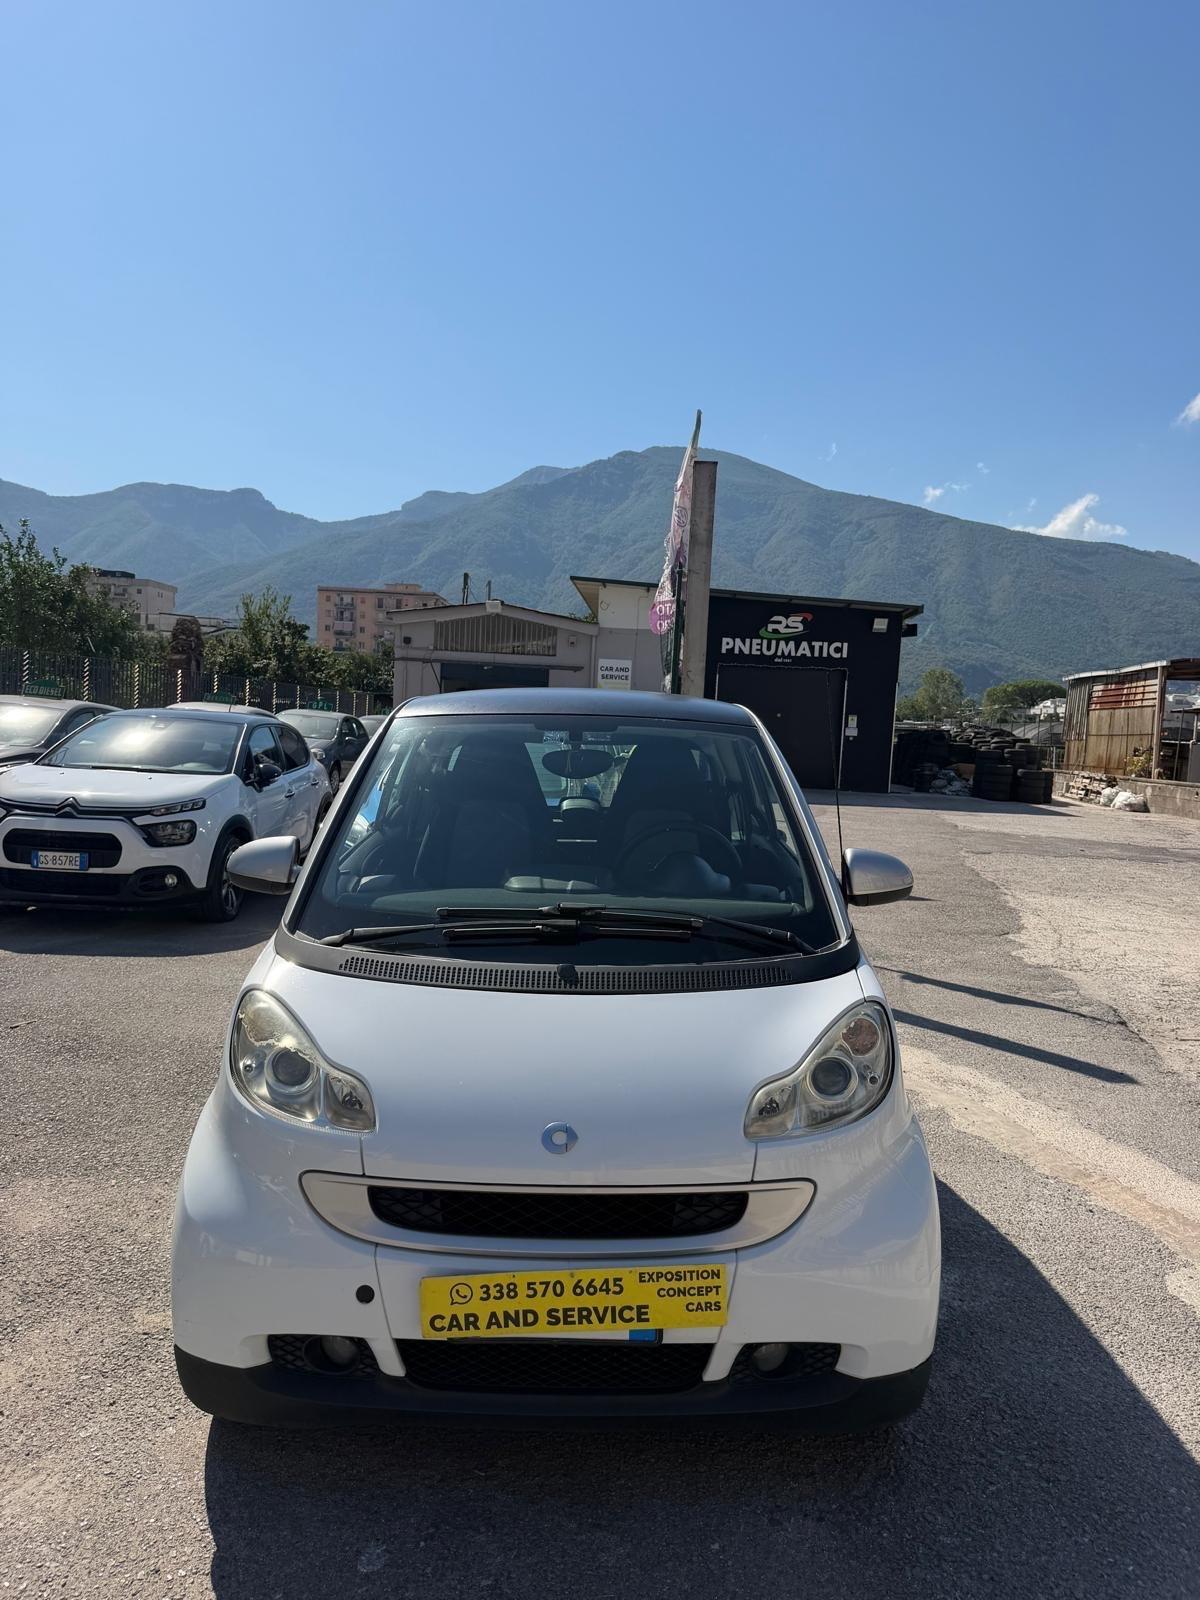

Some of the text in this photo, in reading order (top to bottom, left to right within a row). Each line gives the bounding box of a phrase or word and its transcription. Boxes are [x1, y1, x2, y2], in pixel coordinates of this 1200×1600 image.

[767, 616, 804, 633] RS
[721, 637, 848, 658] PNEUMATICI
[638, 1269, 721, 1284] EXPOSITION
[479, 1277, 624, 1302] 338 570 6645
[656, 1285, 722, 1298] CONCEPT
[685, 1301, 722, 1313] CARS
[429, 1304, 650, 1333] CAR AND SERVICE
